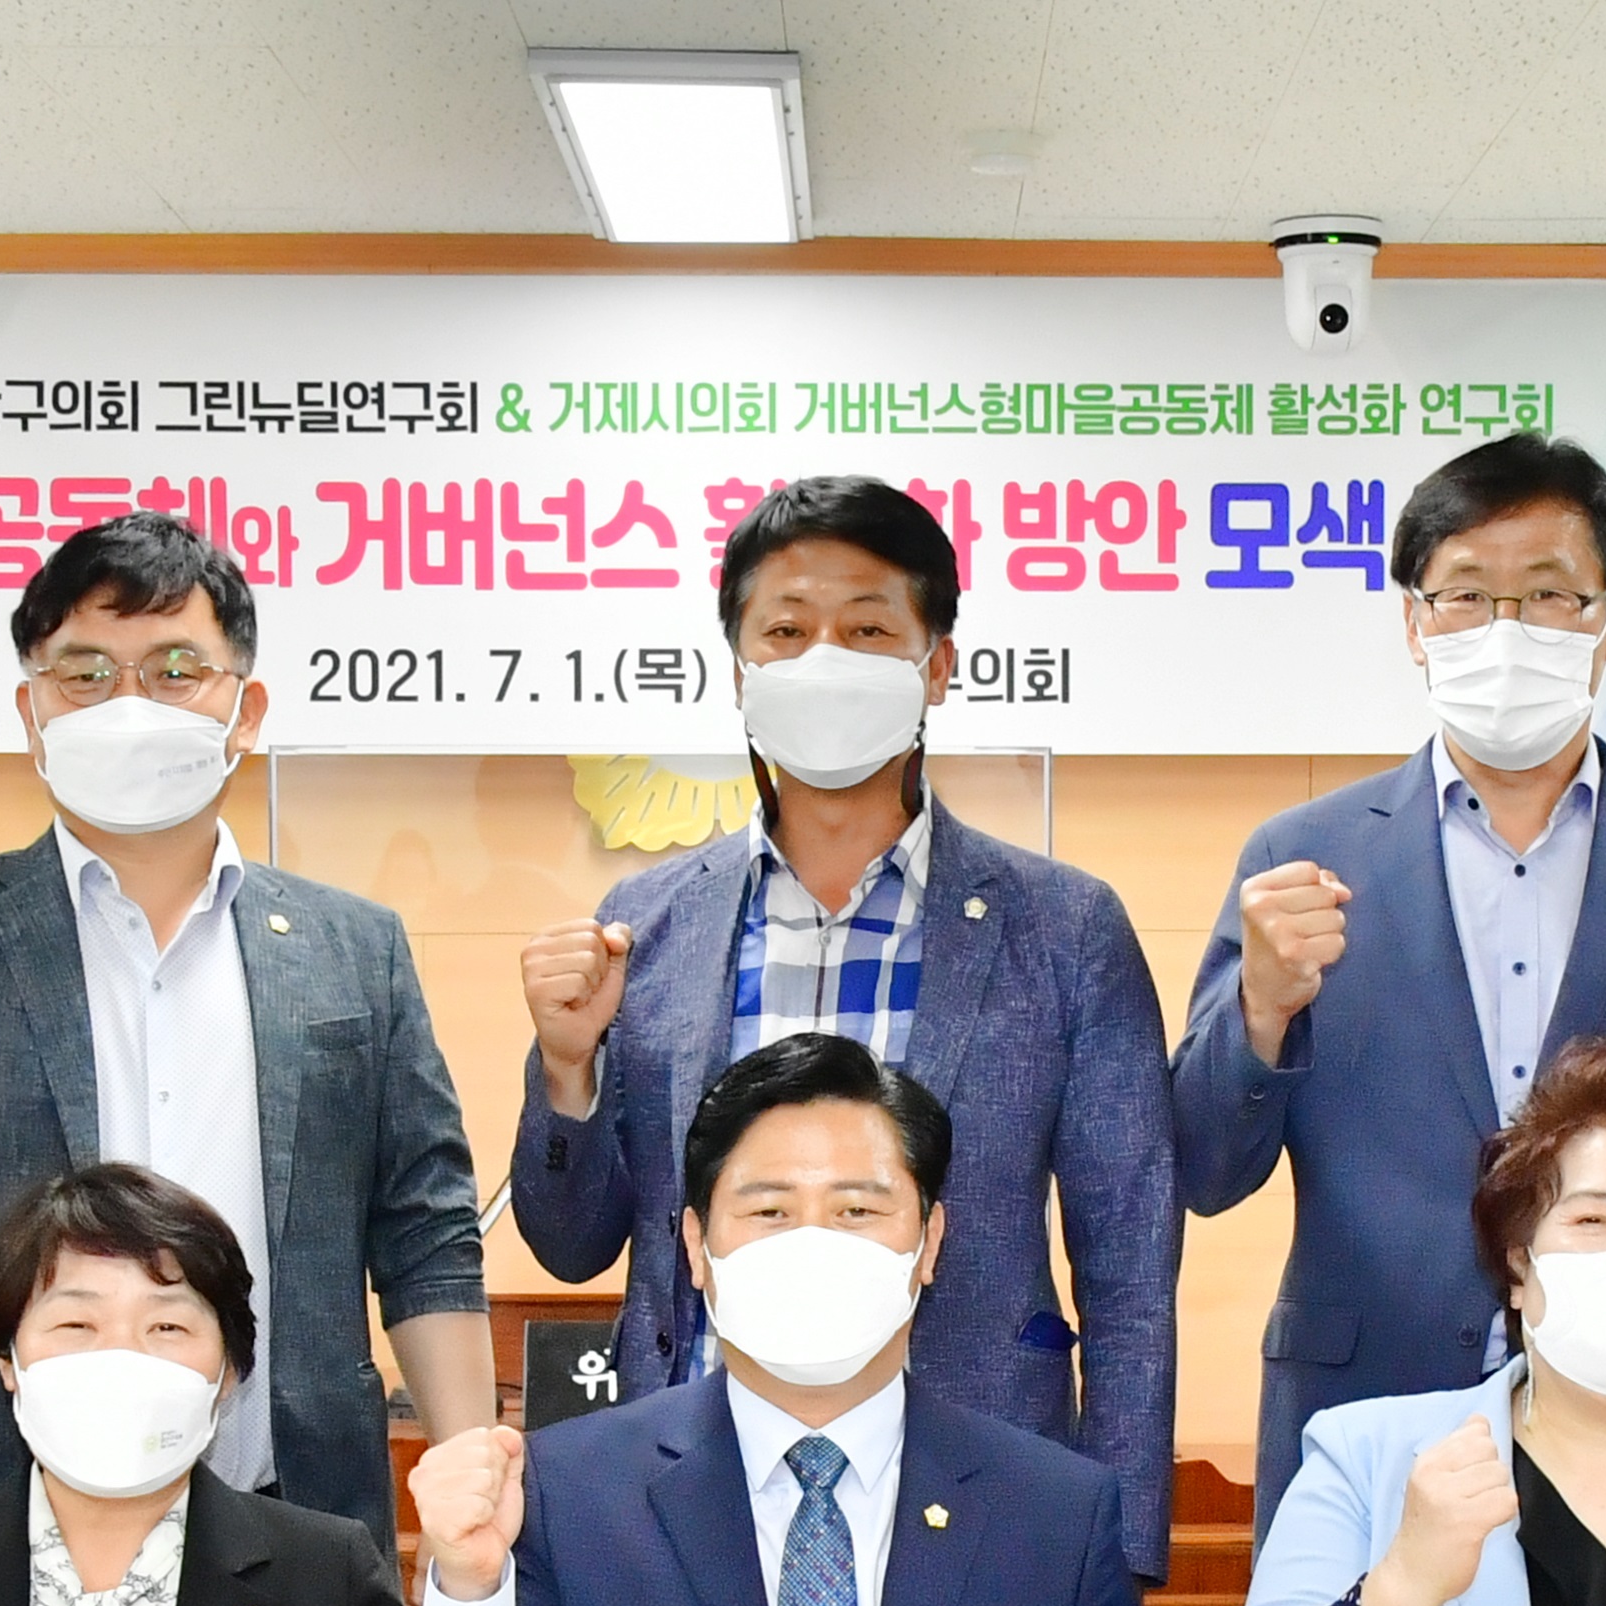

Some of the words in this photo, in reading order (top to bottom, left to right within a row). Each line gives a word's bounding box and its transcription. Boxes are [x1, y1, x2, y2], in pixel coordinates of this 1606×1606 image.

[155, 380, 478, 434] 그린뉴딜연구회
[495, 382, 532, 433] &
[551, 381, 778, 434] 거제시의회
[795, 382, 1255, 436] 거버넌스형마을공동체
[1269, 382, 1408, 436] 활성화
[1420, 383, 1556, 437] 연구회
[315, 477, 680, 591] 거버넌스
[1002, 478, 1188, 592] 방안
[1206, 479, 1386, 592] 모색
[310, 648, 465, 702] 2021.
[489, 649, 539, 702] 7.
